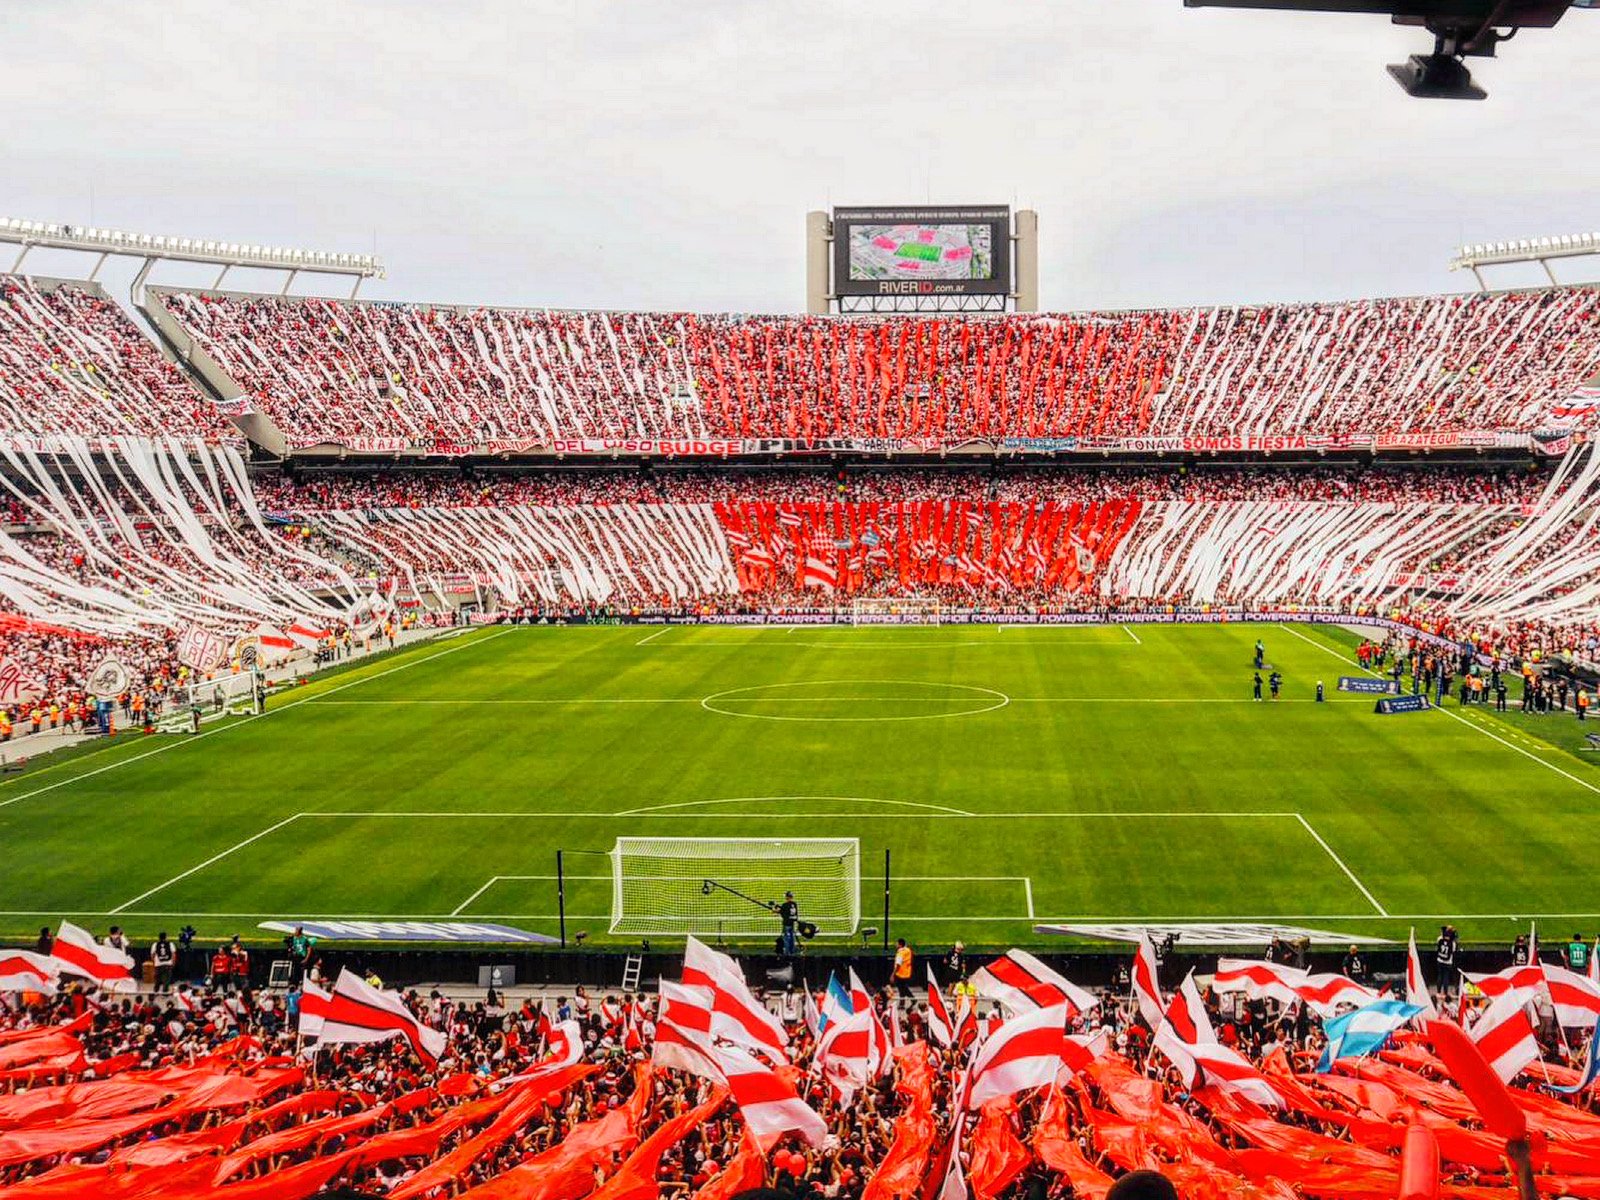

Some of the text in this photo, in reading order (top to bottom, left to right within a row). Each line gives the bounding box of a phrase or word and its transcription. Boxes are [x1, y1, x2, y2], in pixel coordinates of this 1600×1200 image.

[879, 281, 965, 293] RIVERID.com.ar
[1126, 439, 1179, 450] FONAVI
[1183, 437, 1242, 450] SOMOS
[1248, 436, 1305, 449] FIESTA
[1377, 434, 1457, 445] BERAZATEGUI
[554, 440, 593, 452] DEL
[660, 440, 740, 454] BUDGE
